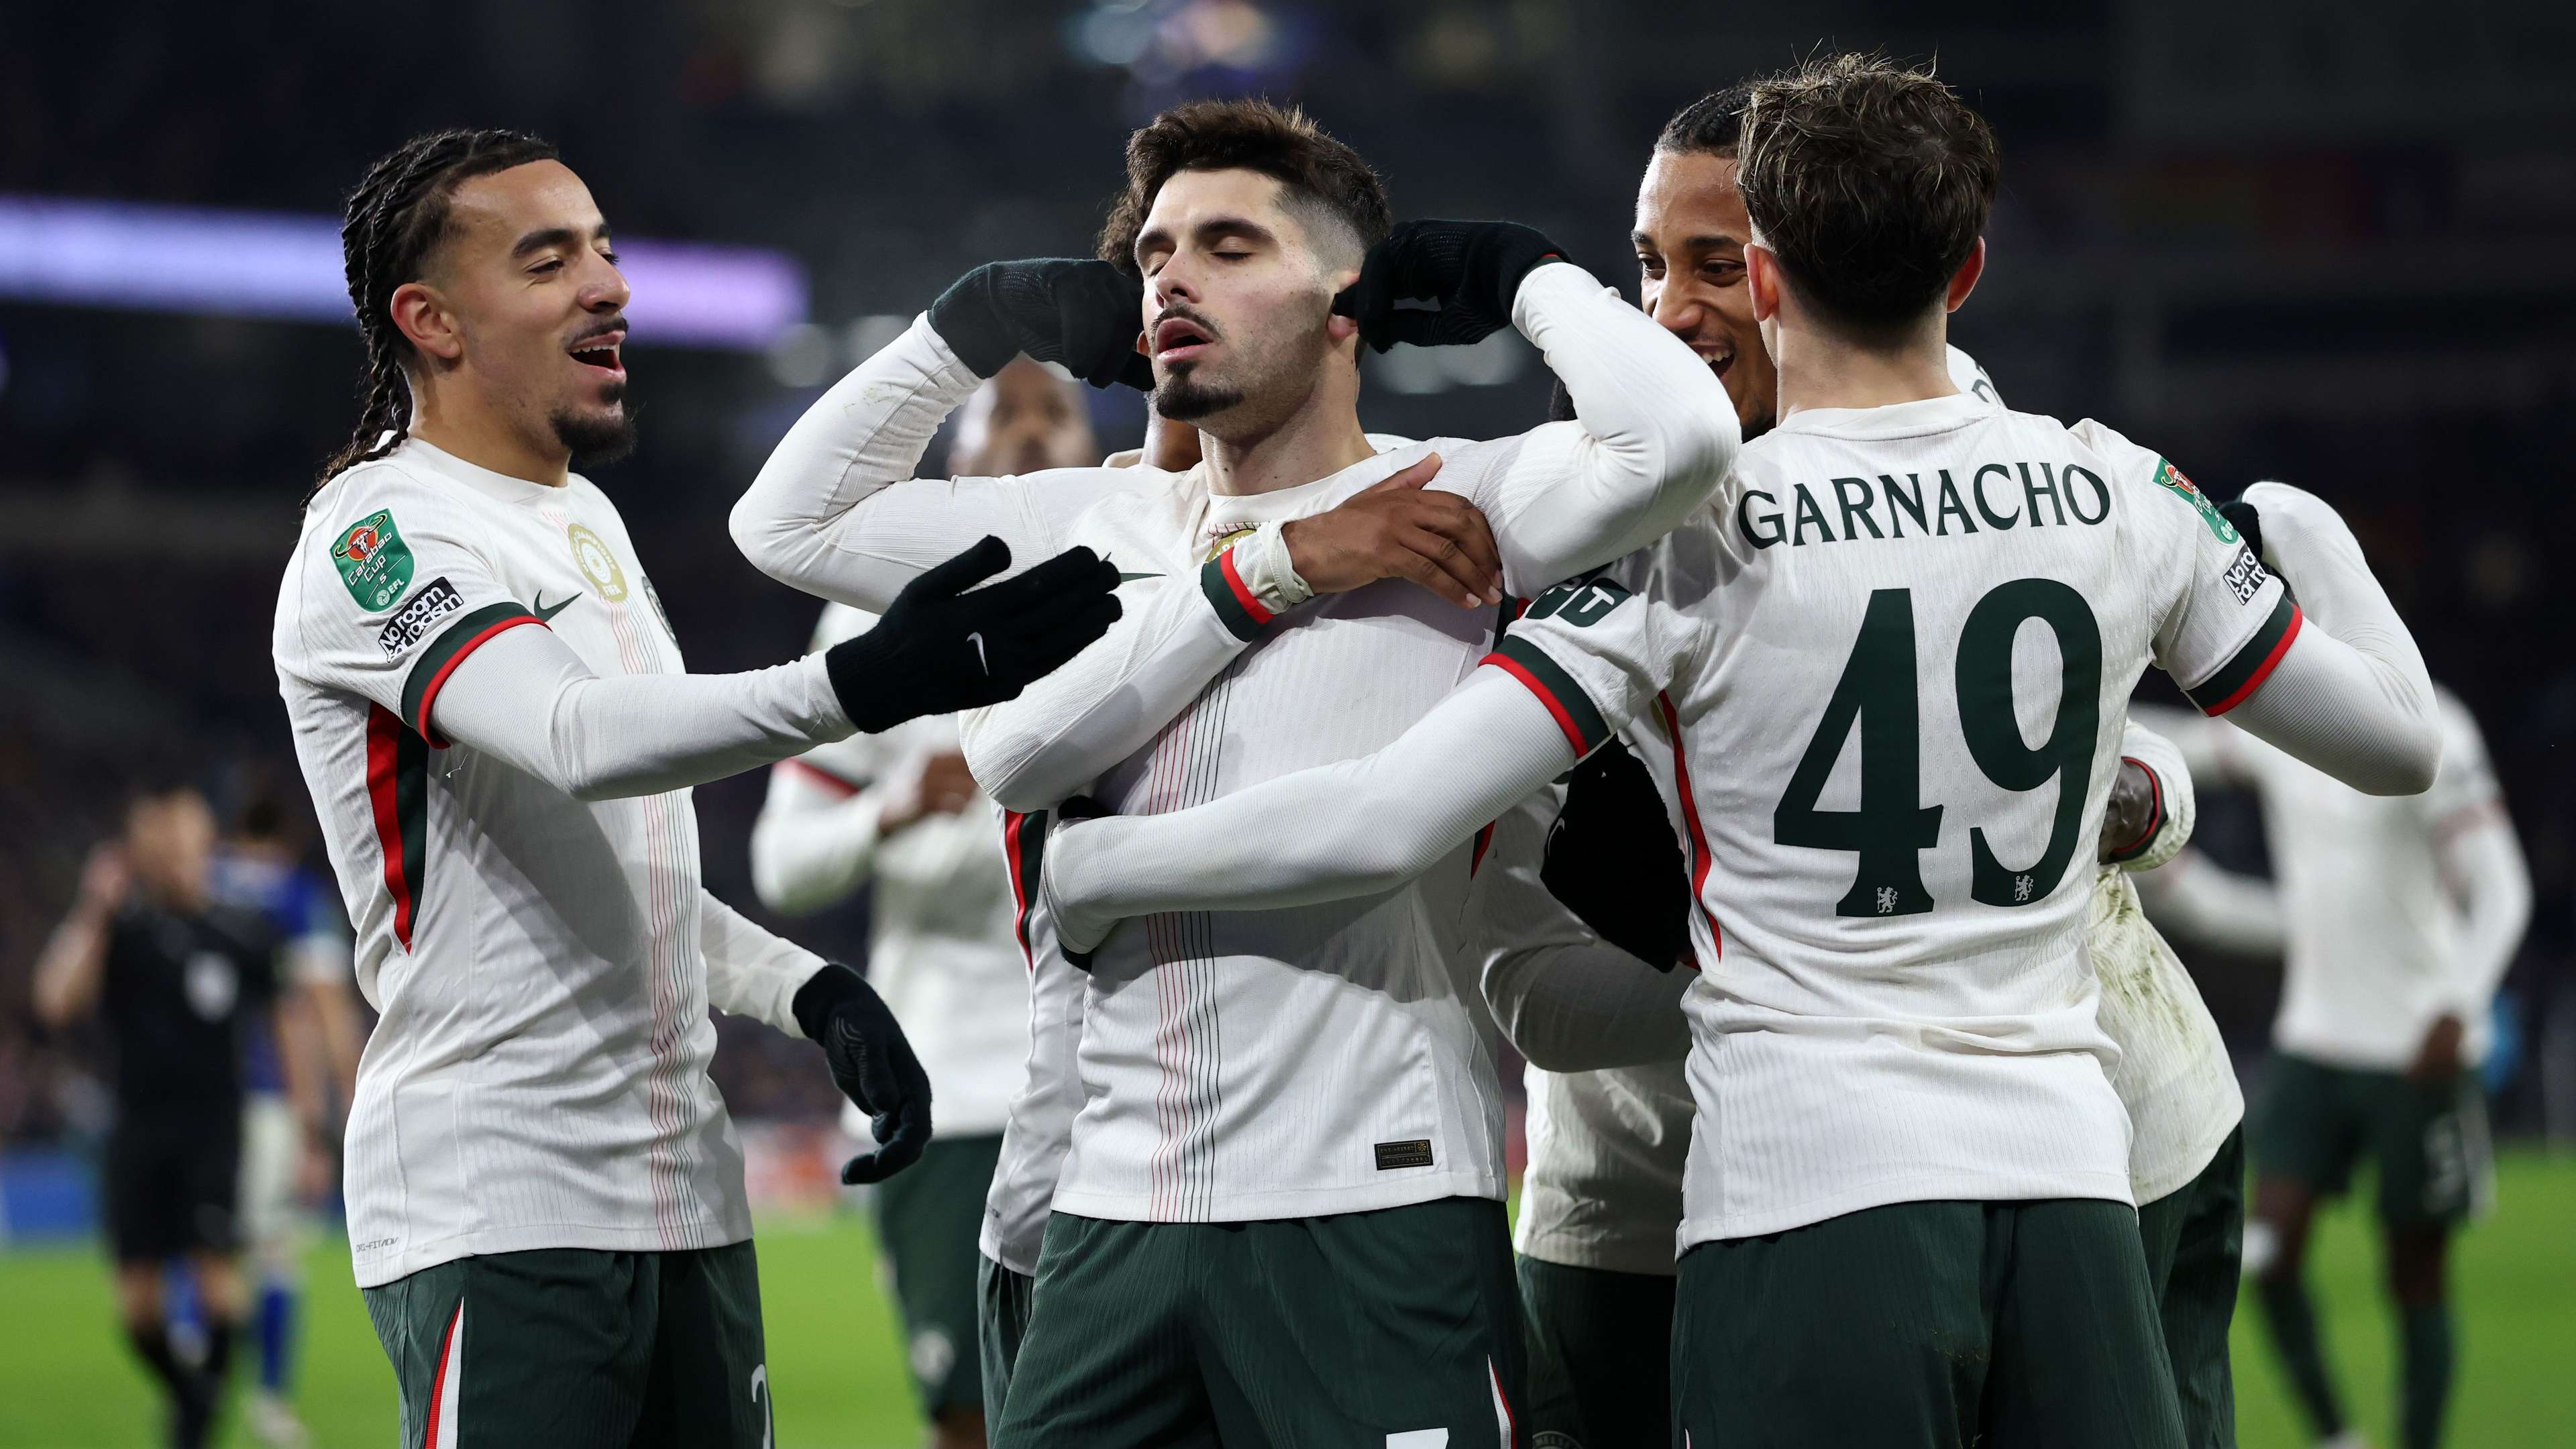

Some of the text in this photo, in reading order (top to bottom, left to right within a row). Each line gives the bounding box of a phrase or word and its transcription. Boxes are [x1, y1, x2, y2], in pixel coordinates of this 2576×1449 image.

[1737, 462, 2111, 549] GARNACHO
[348, 531, 392, 586] Carabao
[2224, 547, 2256, 591] No ro
[388, 578, 405, 594] EFL
[2234, 577, 2256, 604] for
[379, 586, 445, 655] No room
[405, 593, 464, 643] racism
[1773, 578, 2102, 918] 49
